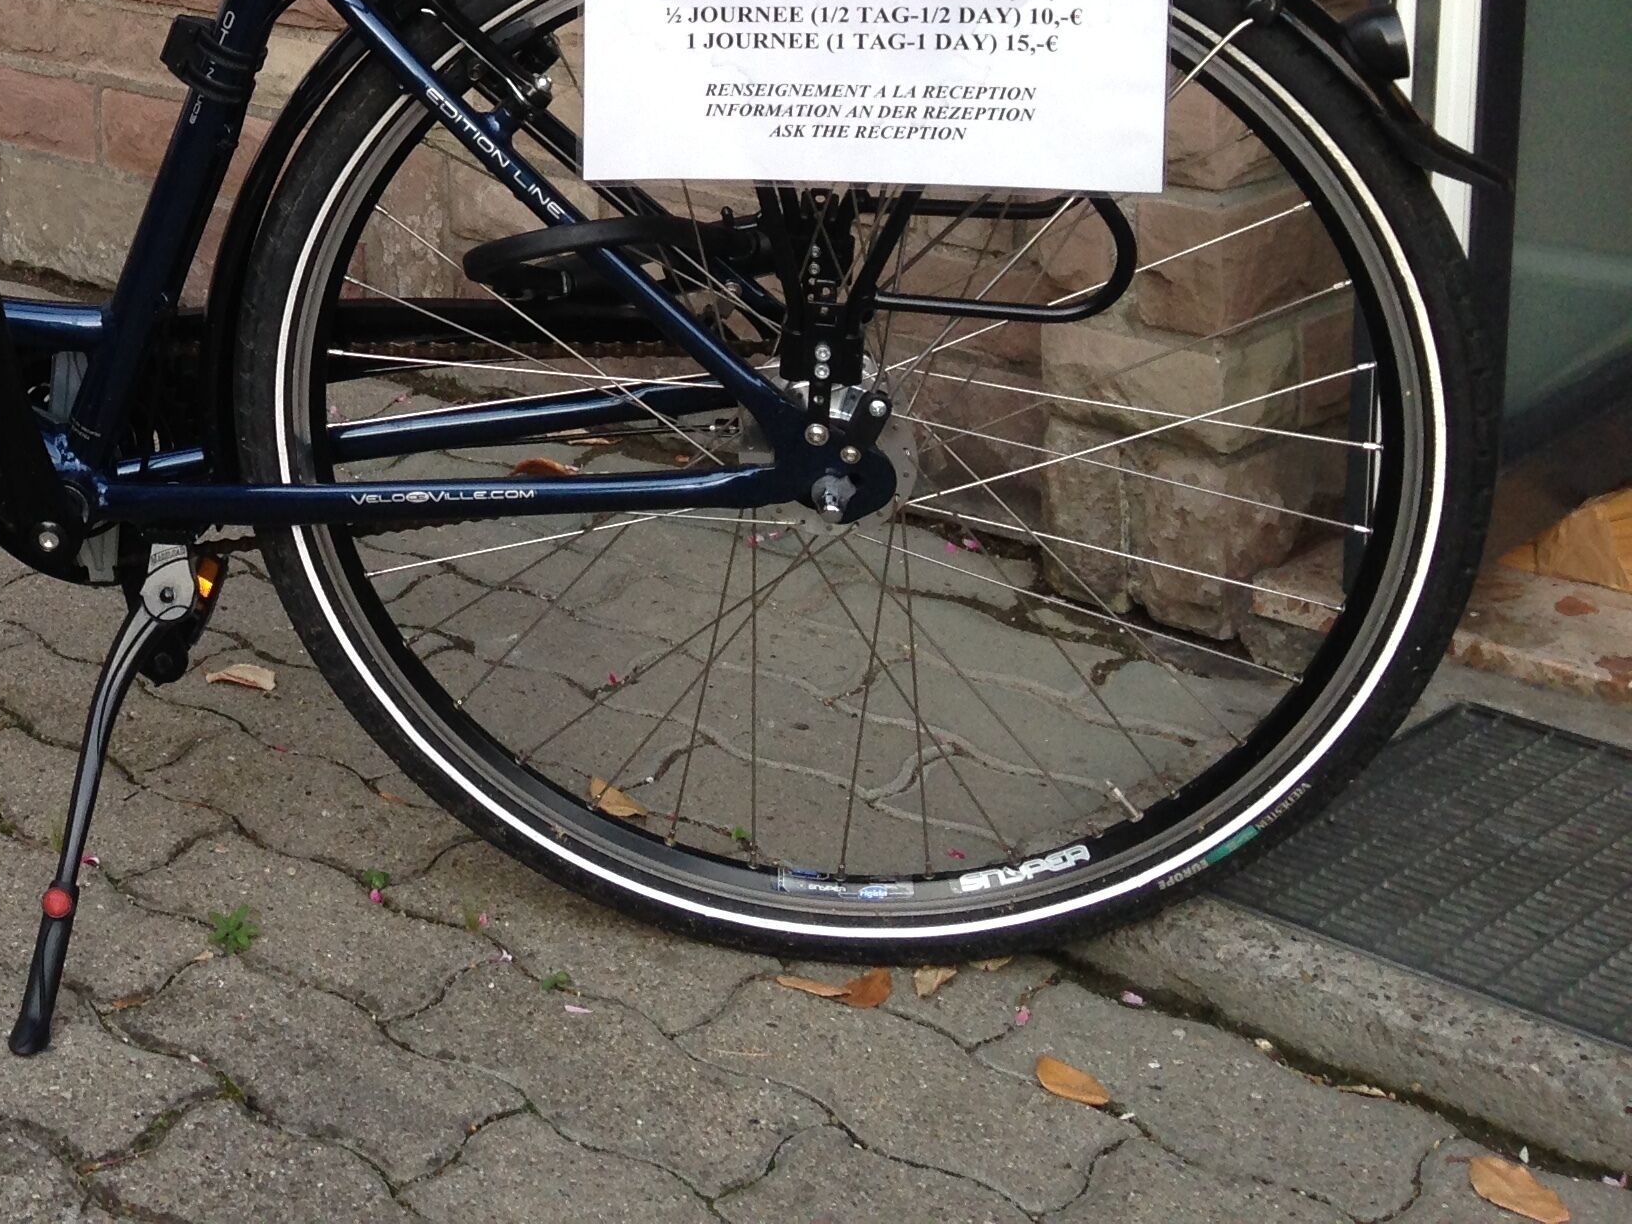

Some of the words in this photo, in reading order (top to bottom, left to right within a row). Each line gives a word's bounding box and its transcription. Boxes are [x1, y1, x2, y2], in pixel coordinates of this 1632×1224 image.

[687, 6, 804, 24] JOURNEE
[810, 6, 850, 27] (1/2
[856, 6, 951, 24] TAG-1/2
[958, 6, 1022, 29] DAY)
[1030, 7, 1083, 29] 10,-€
[687, 32, 695, 50] 1
[702, 32, 820, 50] JOURNEE
[826, 32, 845, 54] (1
[852, 32, 926, 51] TAG-1
[935, 33, 998, 55] DAY)
[1006, 34, 1059, 56] 15,-€
[705, 83, 872, 99] RENSEIGNEMENT
[872, 84, 887, 98] A
[891, 84, 917, 99] LA
[921, 85, 1037, 101] RECEPTION
[705, 103, 842, 119] INFORMATION
[845, 104, 874, 119] AN
[877, 105, 918, 119] DER
[922, 105, 1036, 122] REZEPTION
[768, 124, 807, 138] ASK
[811, 124, 851, 139] THE
[854, 125, 967, 141] RECEPTION
[426, 87, 511, 168] EDITION
[513, 170, 565, 220] LINE
